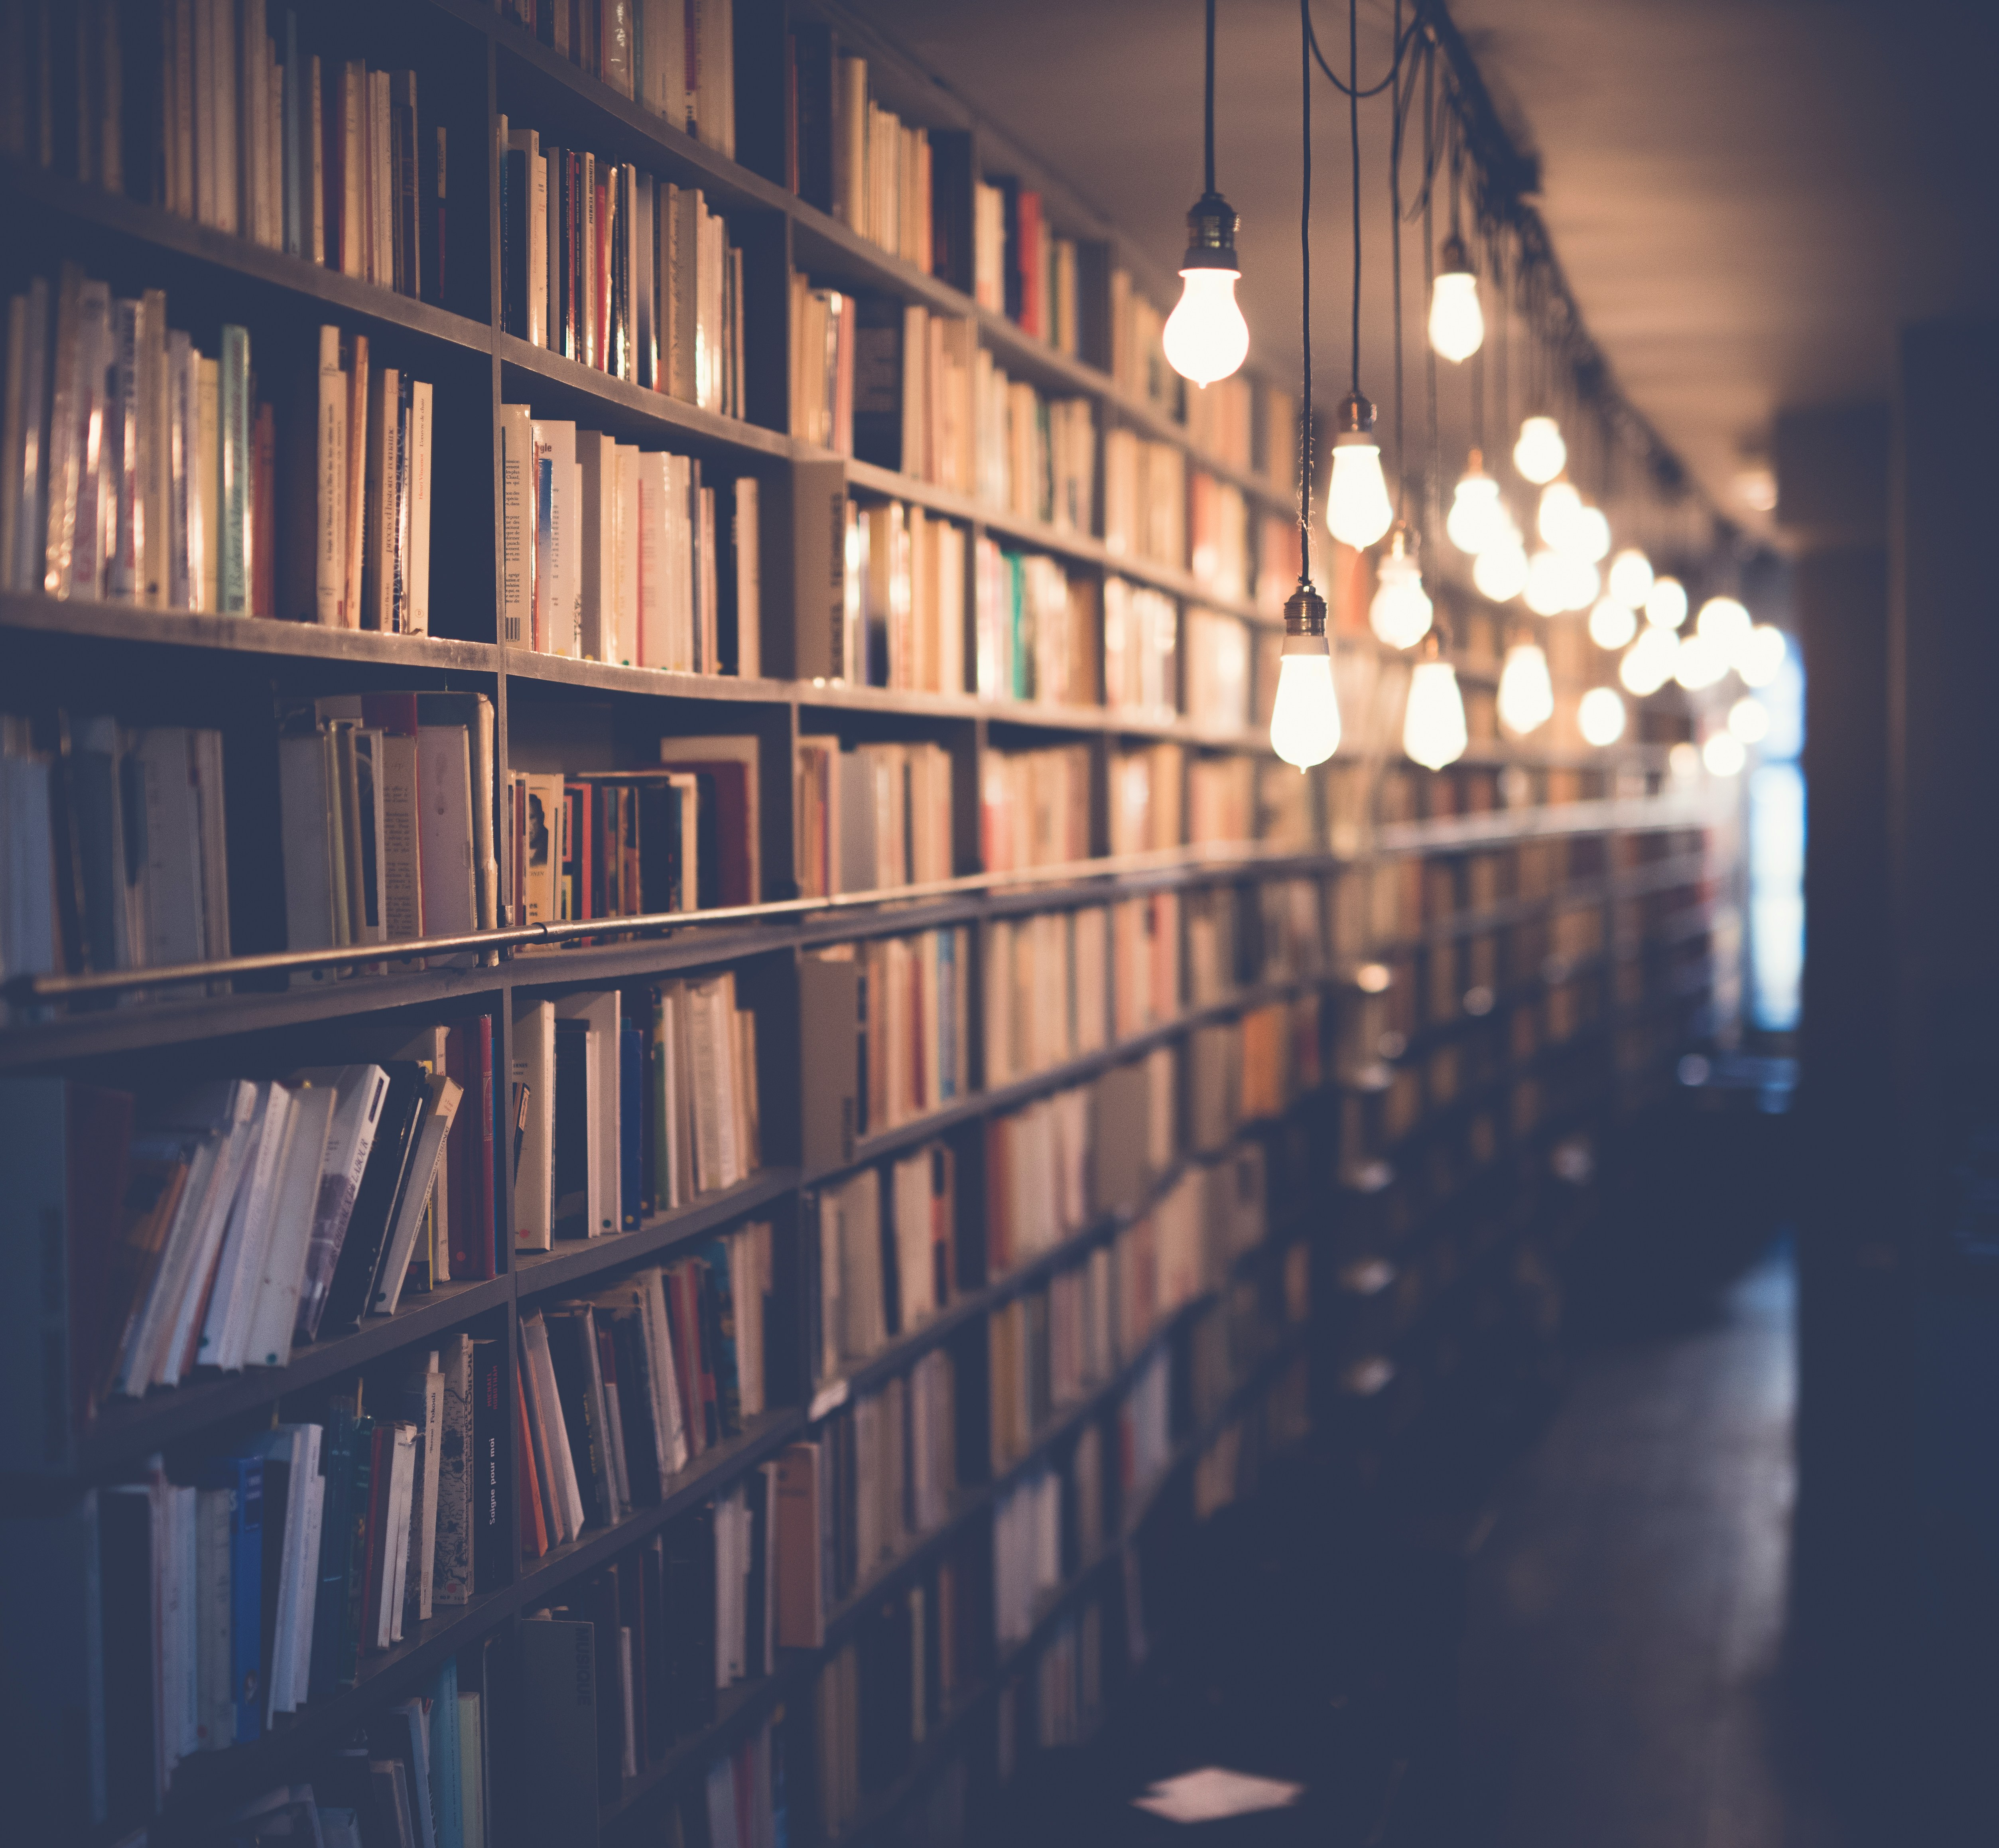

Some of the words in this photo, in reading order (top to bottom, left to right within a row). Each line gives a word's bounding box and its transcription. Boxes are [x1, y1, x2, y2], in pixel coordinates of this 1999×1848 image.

[385, 522, 393, 553] précis
[349, 1138, 369, 1183] LABOUR
[435, 1126, 450, 1162] DONATELLO
[575, 1627, 591, 1706] MUSIQUE
